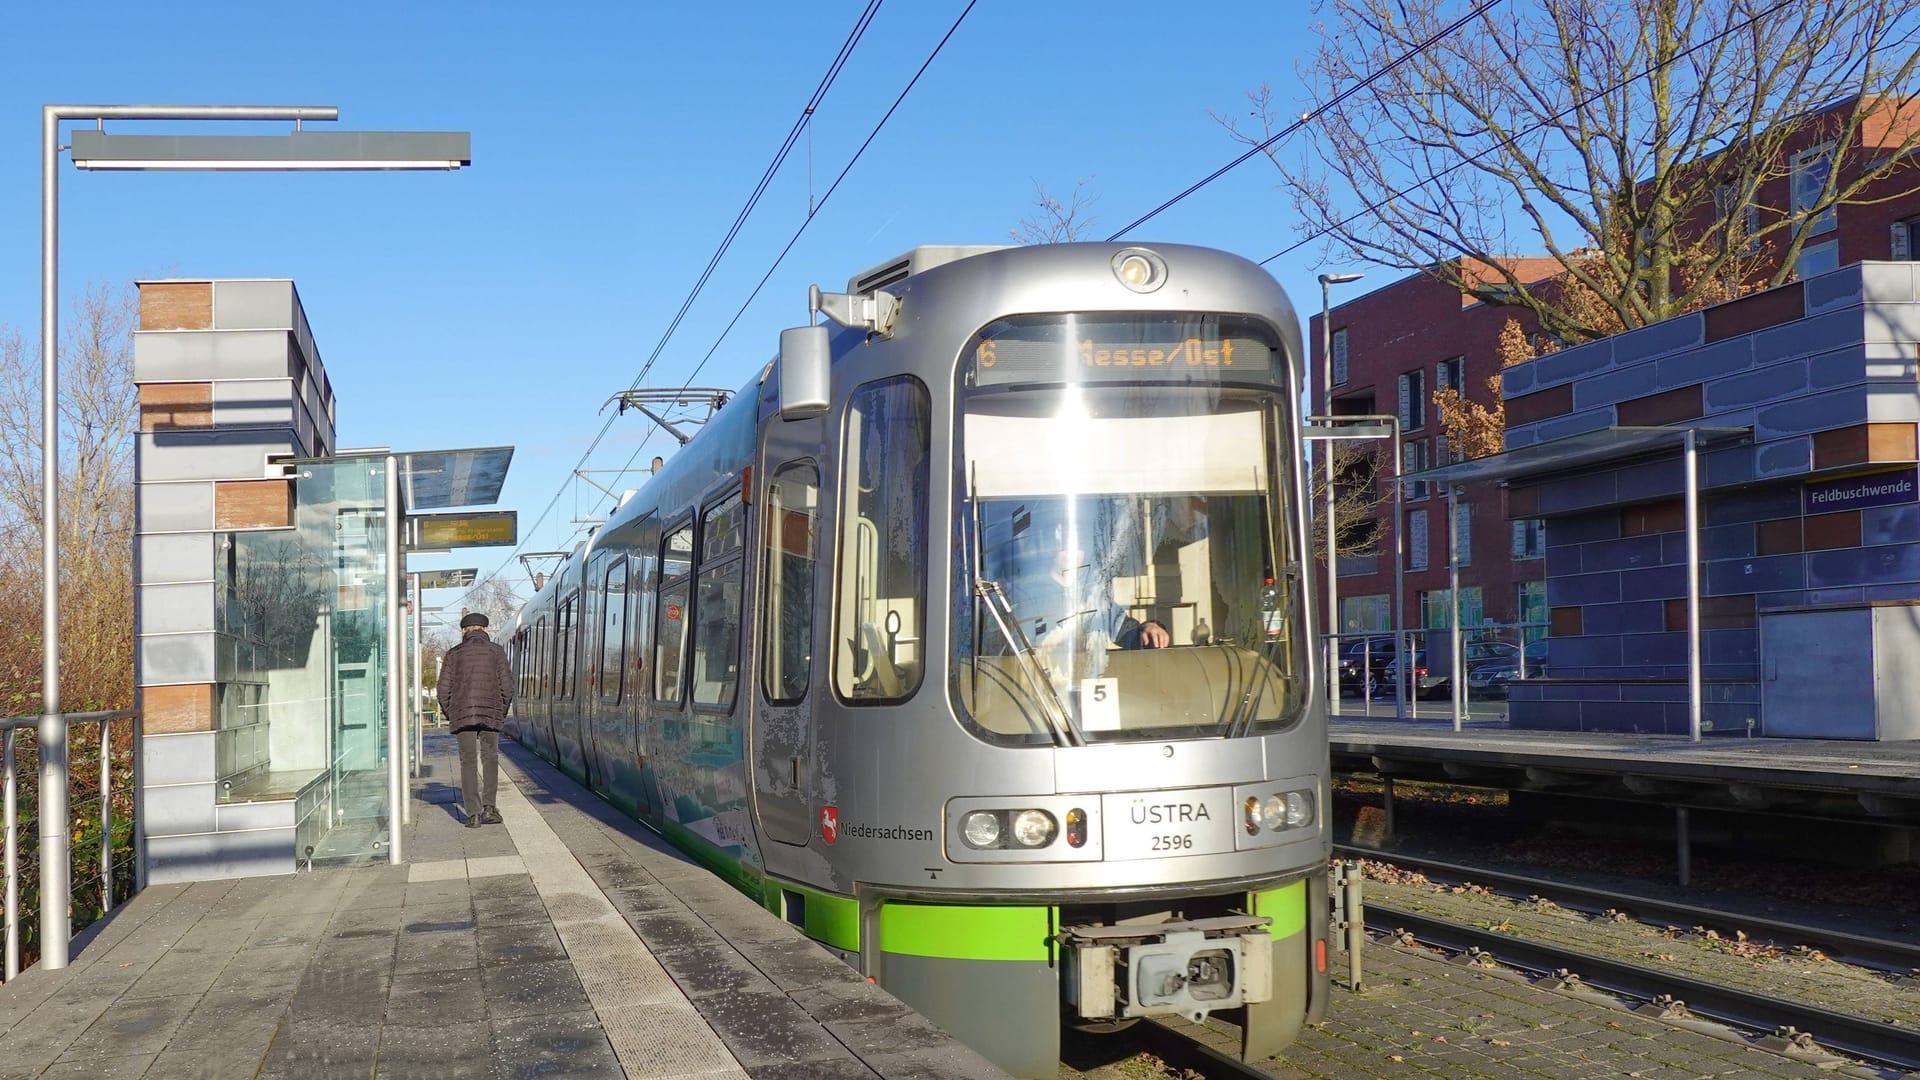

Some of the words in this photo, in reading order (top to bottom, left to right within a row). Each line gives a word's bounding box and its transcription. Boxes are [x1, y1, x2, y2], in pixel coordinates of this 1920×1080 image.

[979, 339, 997, 367] 6
[1077, 339, 1233, 367] Messe/Ost
[1811, 480, 1912, 503] Feldbuschwende
[1093, 684, 1107, 703] 5
[1130, 799, 1211, 825] ÜSTRA
[840, 822, 933, 840] Niedersachsen
[1151, 835, 1192, 851] 2596
